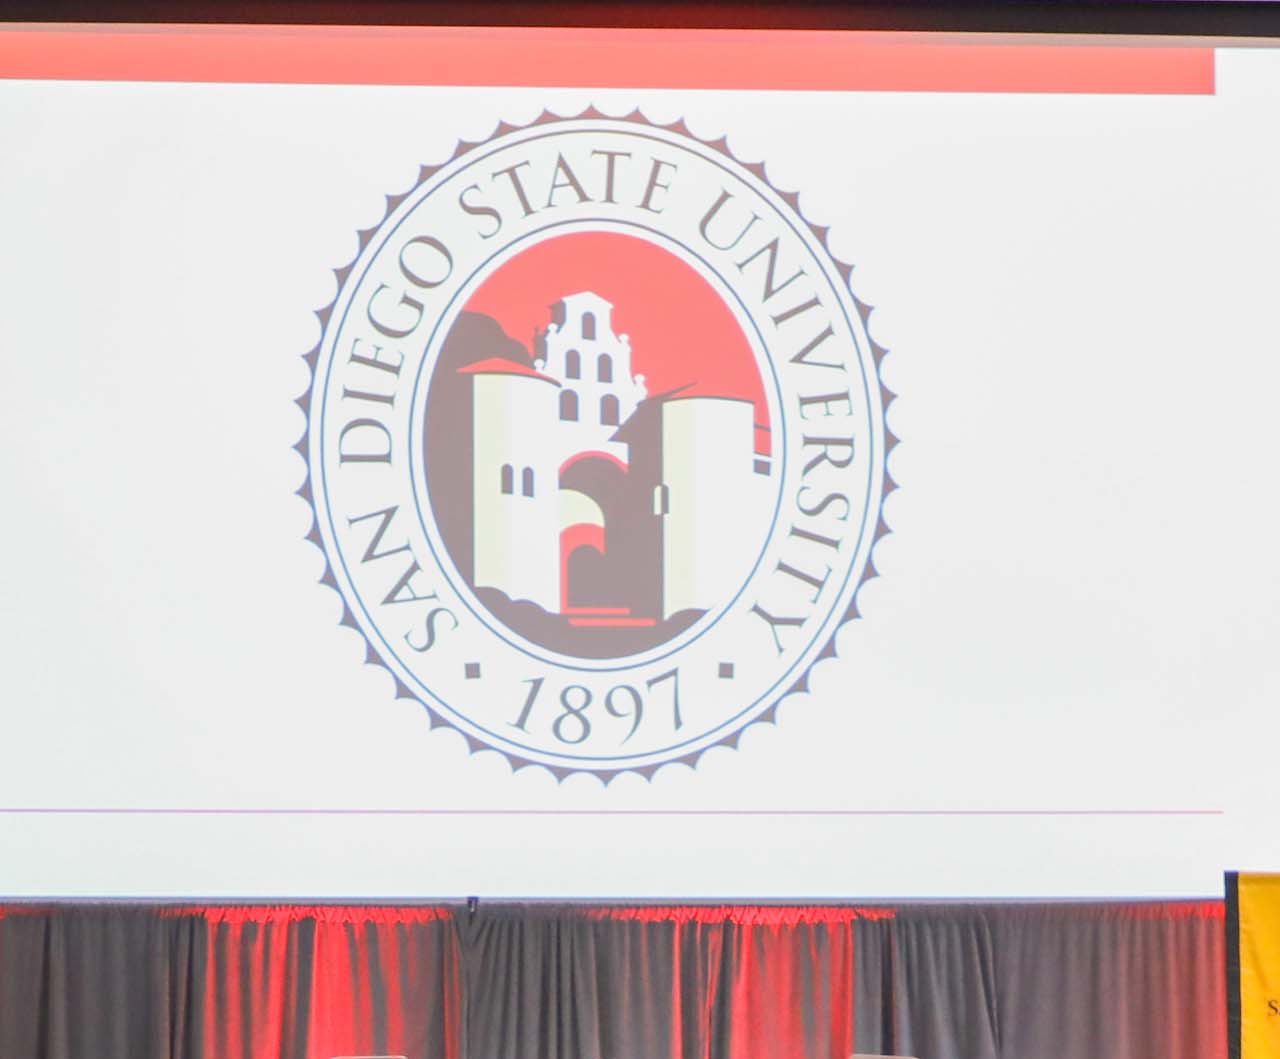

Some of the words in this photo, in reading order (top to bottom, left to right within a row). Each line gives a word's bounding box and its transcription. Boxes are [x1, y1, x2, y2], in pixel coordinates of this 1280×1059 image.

[456, 148, 680, 240] STATE
[338, 234, 456, 468] DIEGO
[696, 187, 857, 656] UNIVERSITY
[347, 503, 461, 655] SAN
[505, 666, 684, 745] 1897
